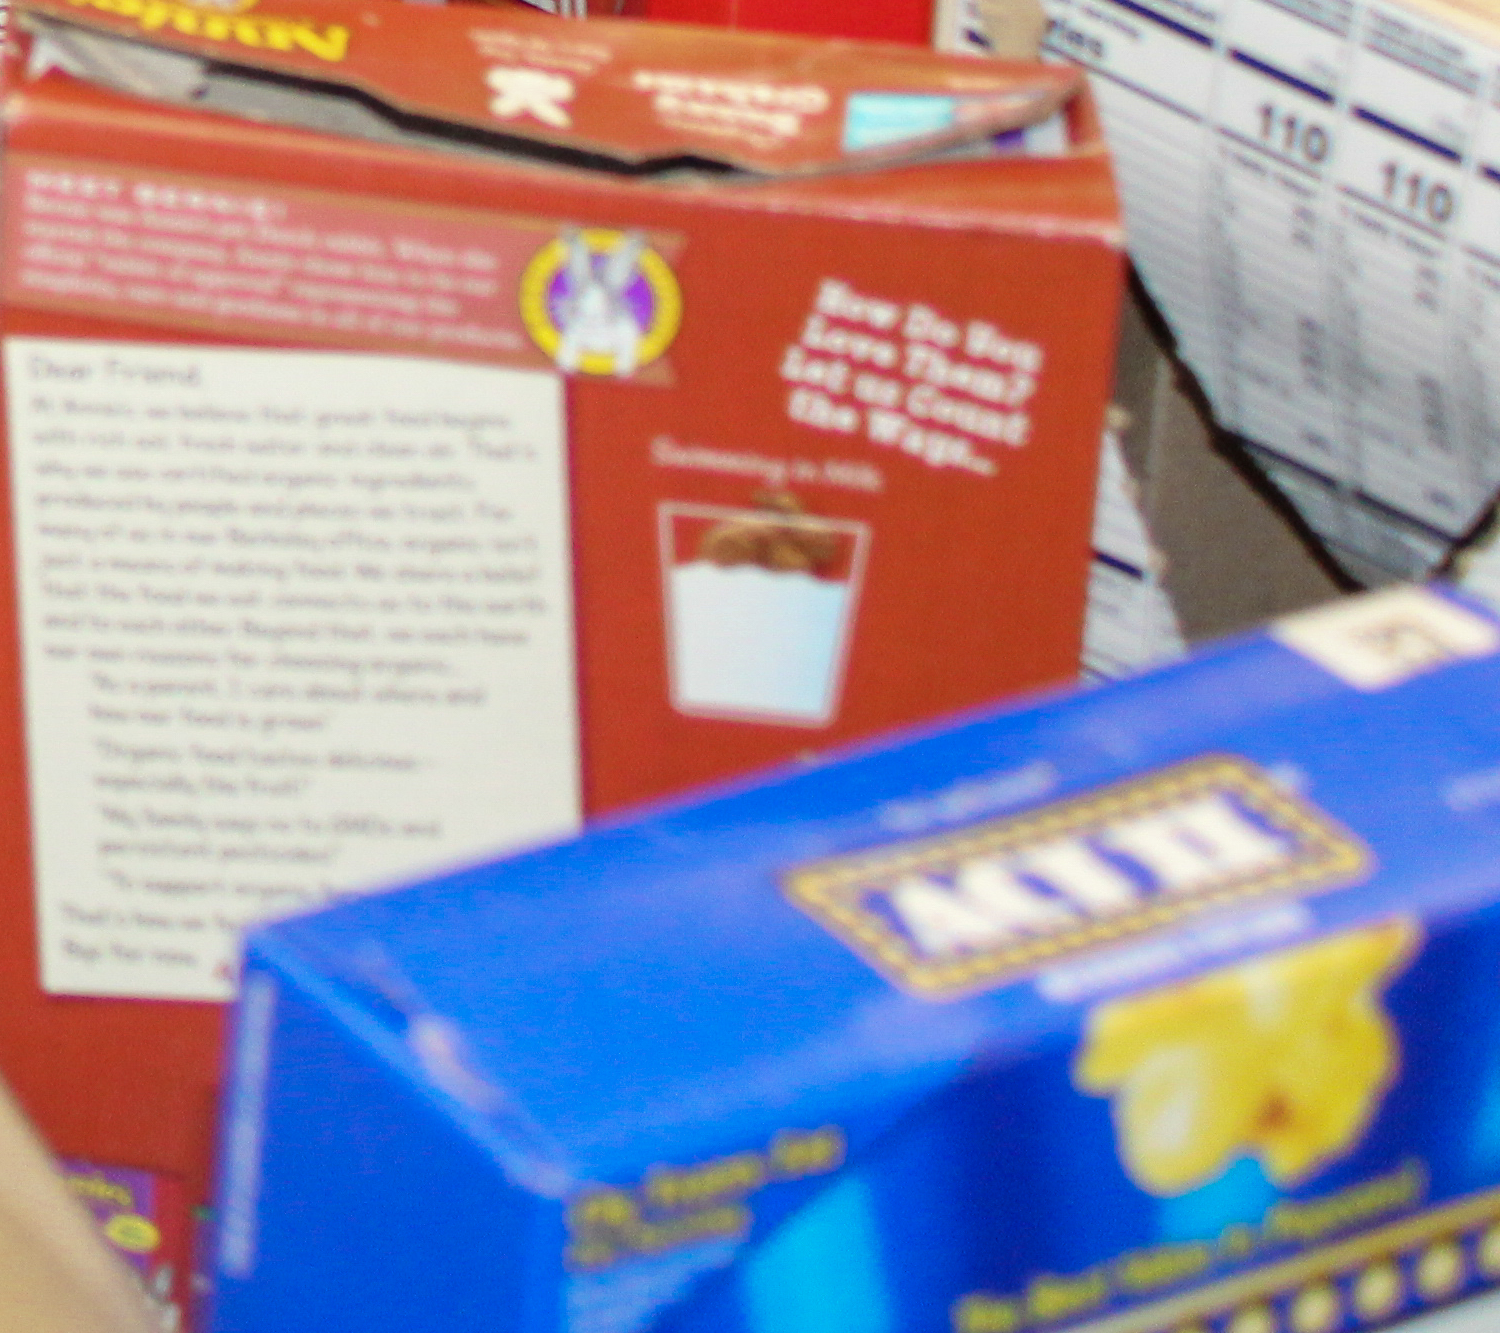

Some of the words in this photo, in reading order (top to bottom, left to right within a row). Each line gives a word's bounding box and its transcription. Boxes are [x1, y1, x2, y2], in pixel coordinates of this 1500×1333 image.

[1253, 103, 1330, 162] 110
[1379, 162, 1453, 226] 110
[802, 313, 897, 366] Love
[904, 342, 1037, 408] Them?
[814, 276, 901, 329] How
[904, 301, 960, 348] Do
[966, 318, 1044, 373] You
[780, 344, 850, 393] Let
[853, 371, 902, 408] us
[906, 383, 1031, 448] Count
[786, 388, 861, 434] the
[893, 838, 1134, 960] ACT
